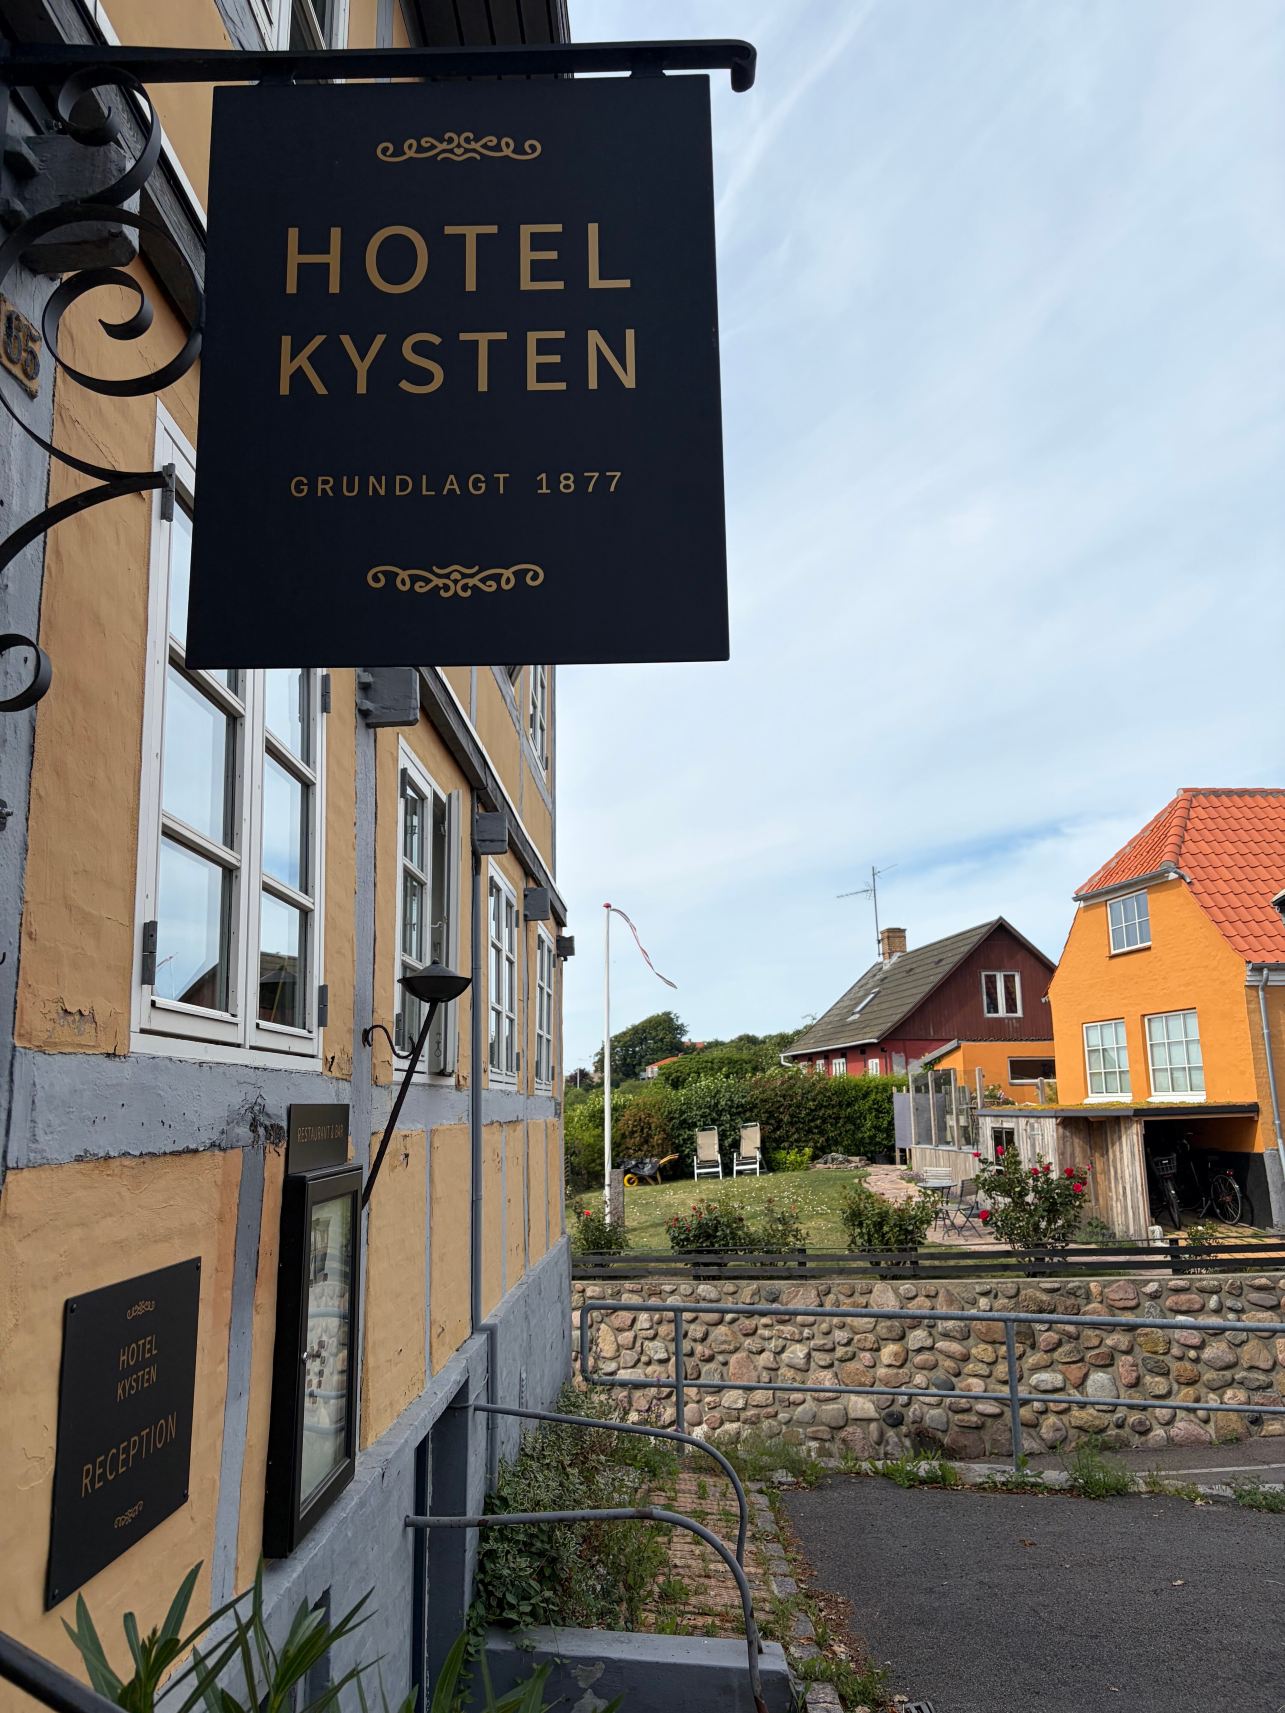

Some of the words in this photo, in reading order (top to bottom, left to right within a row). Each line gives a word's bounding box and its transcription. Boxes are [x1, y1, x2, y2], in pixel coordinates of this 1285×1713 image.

[285, 222, 632, 296] HOTEL
[278, 328, 637, 397] KYSTEN
[290, 472, 511, 498] GRUNDLAGT
[536, 471, 623, 495] 1877
[297, 1125, 330, 1143] RESTAURANT
[119, 1334, 158, 1371] HOTEL
[116, 1364, 157, 1402] KYSTEN
[81, 1411, 177, 1498] RECEPTION
